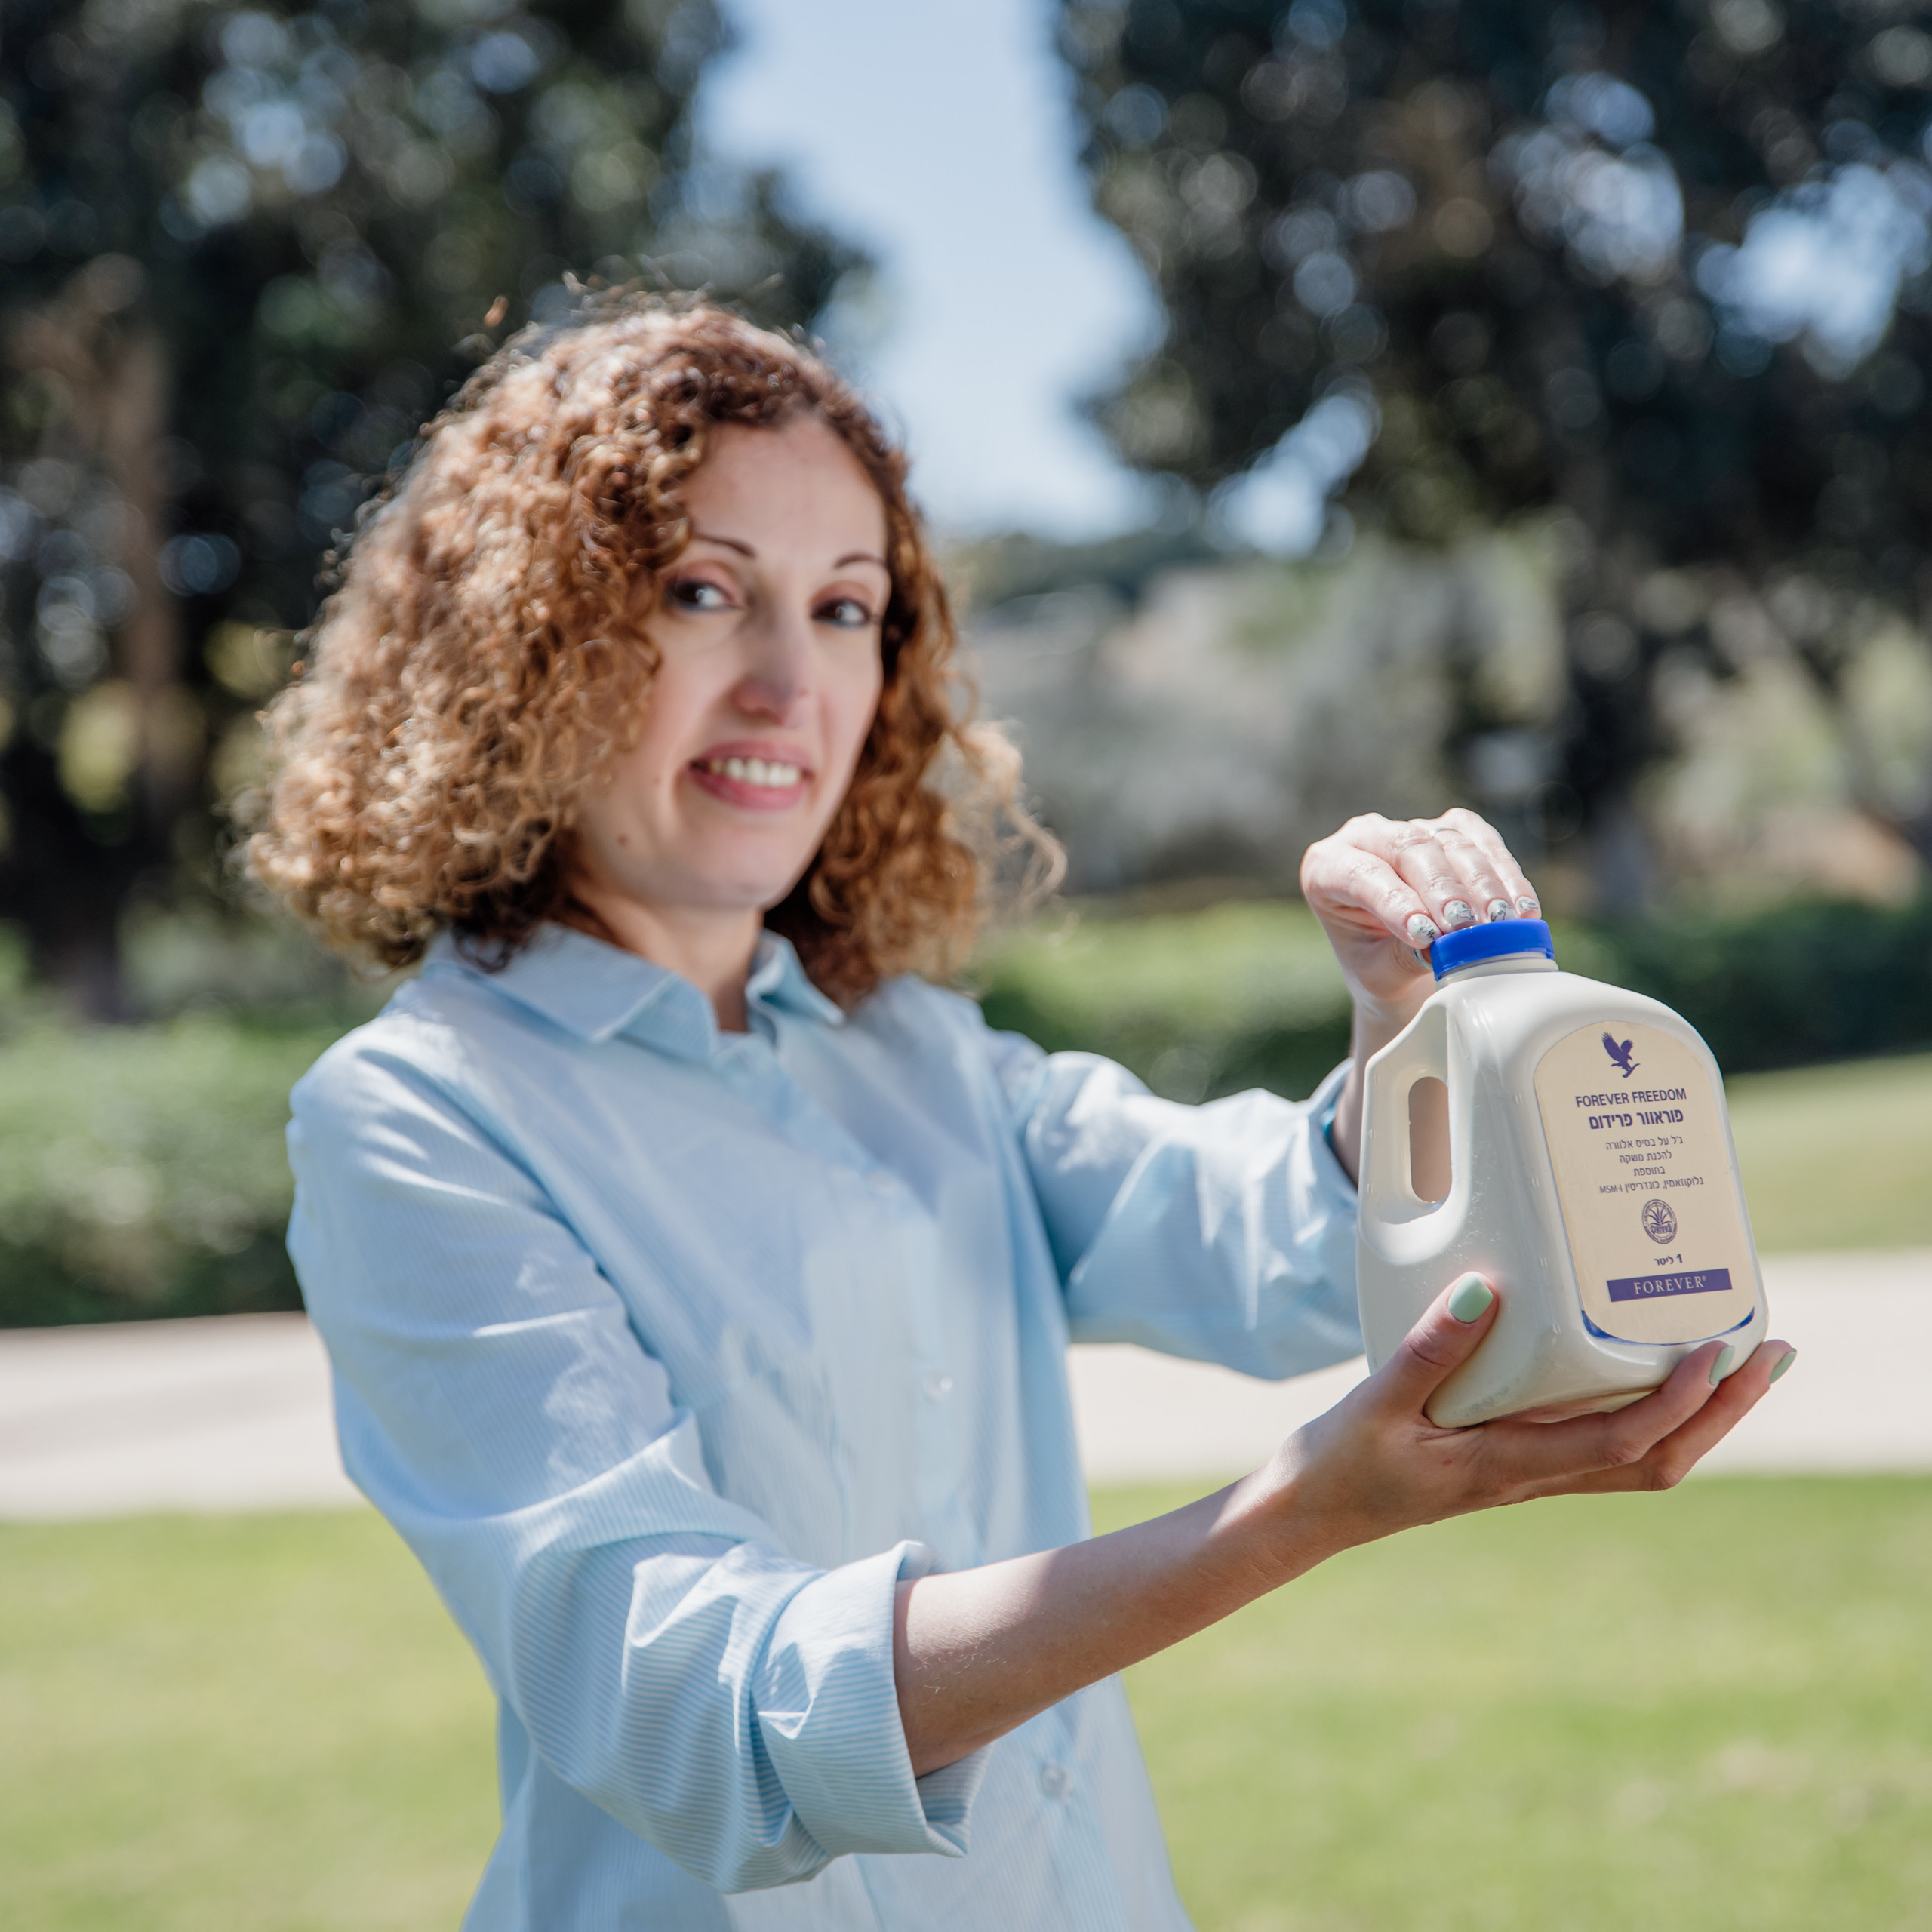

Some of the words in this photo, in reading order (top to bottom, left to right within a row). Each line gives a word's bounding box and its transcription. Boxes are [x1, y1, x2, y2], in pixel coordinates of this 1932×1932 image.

[1575, 1093, 1631, 1108] FOREVER
[1631, 1088, 1687, 1103] FREEDOM
[1588, 1114, 1633, 1130] פרידום
[1635, 1109, 1684, 1126] פוראוור
[1605, 1140, 1634, 1150] אלוורה
[1635, 1139, 1657, 1148] בסיס
[1657, 1136, 1669, 1146] על
[1619, 1154, 1644, 1165] משקה
[1647, 1150, 1672, 1161] להכנת
[1633, 1167, 1666, 1177] בתוספת
[1654, 1256, 1675, 1266] ליטר
[1675, 1254, 1683, 1264] 1
